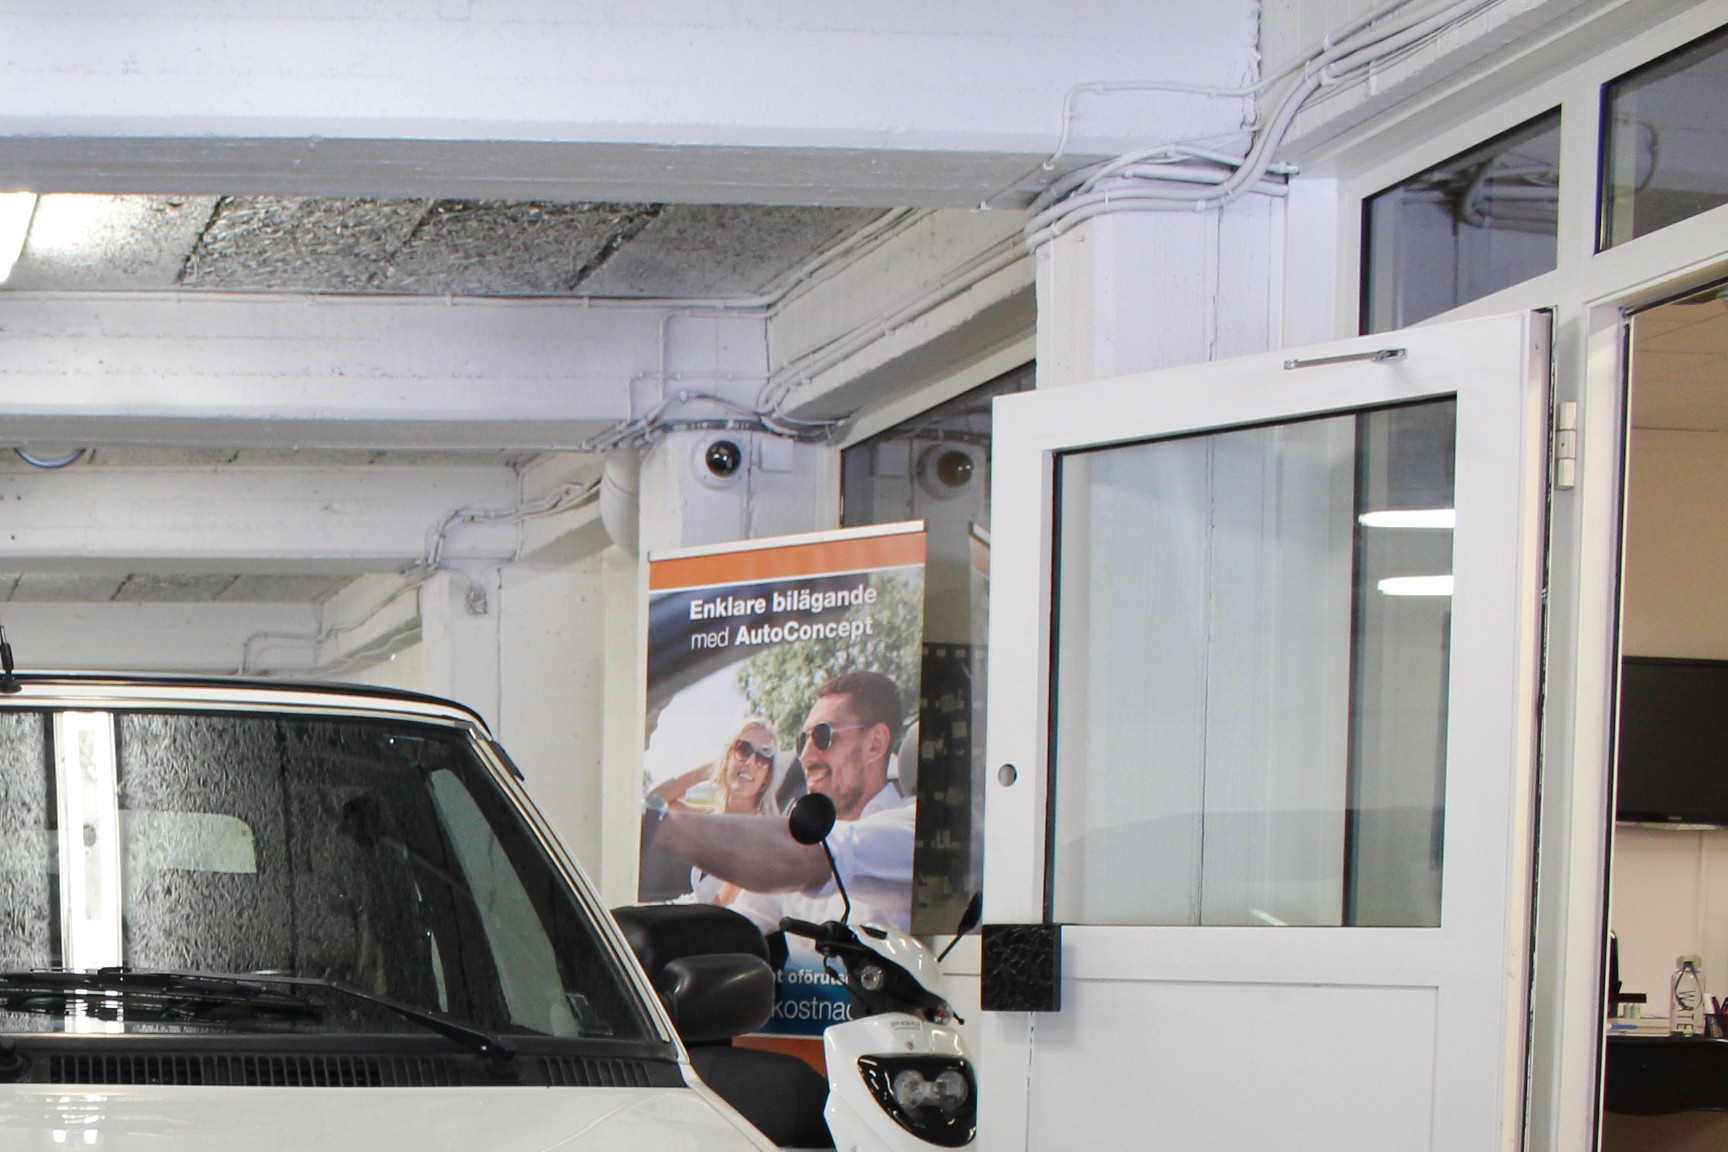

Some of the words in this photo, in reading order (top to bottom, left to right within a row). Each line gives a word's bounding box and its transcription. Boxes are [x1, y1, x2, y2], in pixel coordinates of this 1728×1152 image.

[690, 596, 767, 620] Enklare
[772, 584, 877, 613] bilägande
[691, 627, 729, 650] med
[734, 619, 874, 646] AutoConcept
